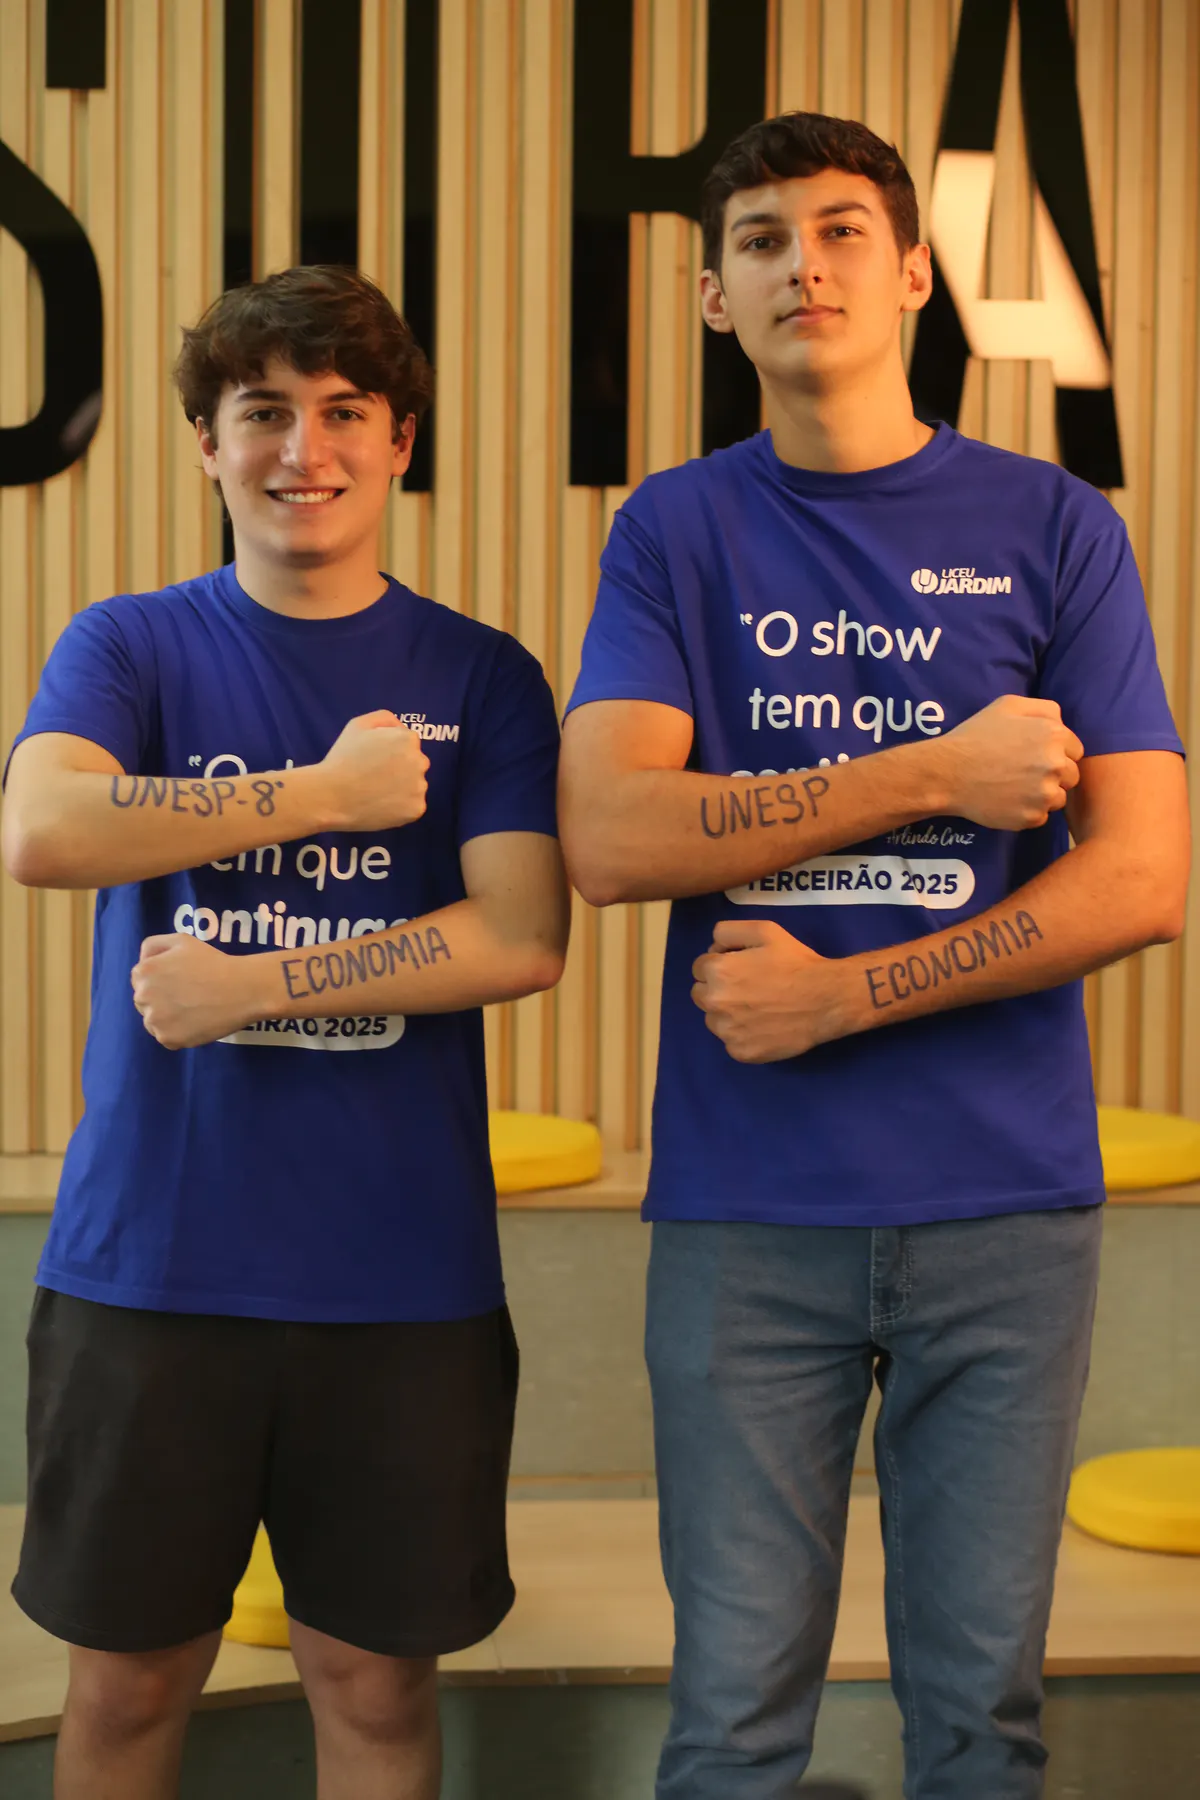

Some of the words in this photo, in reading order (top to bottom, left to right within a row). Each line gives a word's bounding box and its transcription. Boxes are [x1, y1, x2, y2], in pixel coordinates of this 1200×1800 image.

[941, 567, 976, 578] LICEU
[935, 576, 1012, 595] JARDIM
[811, 610, 942, 661] show
[394, 713, 426, 723] ICEU
[749, 688, 840, 730] tem
[852, 694, 945, 743] que
[402, 723, 460, 742] RDIM
[701, 776, 830, 839] UNESP
[940, 826, 976, 847] Cruz
[296, 844, 391, 891] que
[901, 870, 958, 895] 2025
[281, 926, 451, 999] ECONOMIA
[866, 910, 1043, 1009] ECONOMIA
[324, 1016, 388, 1037] 2025
